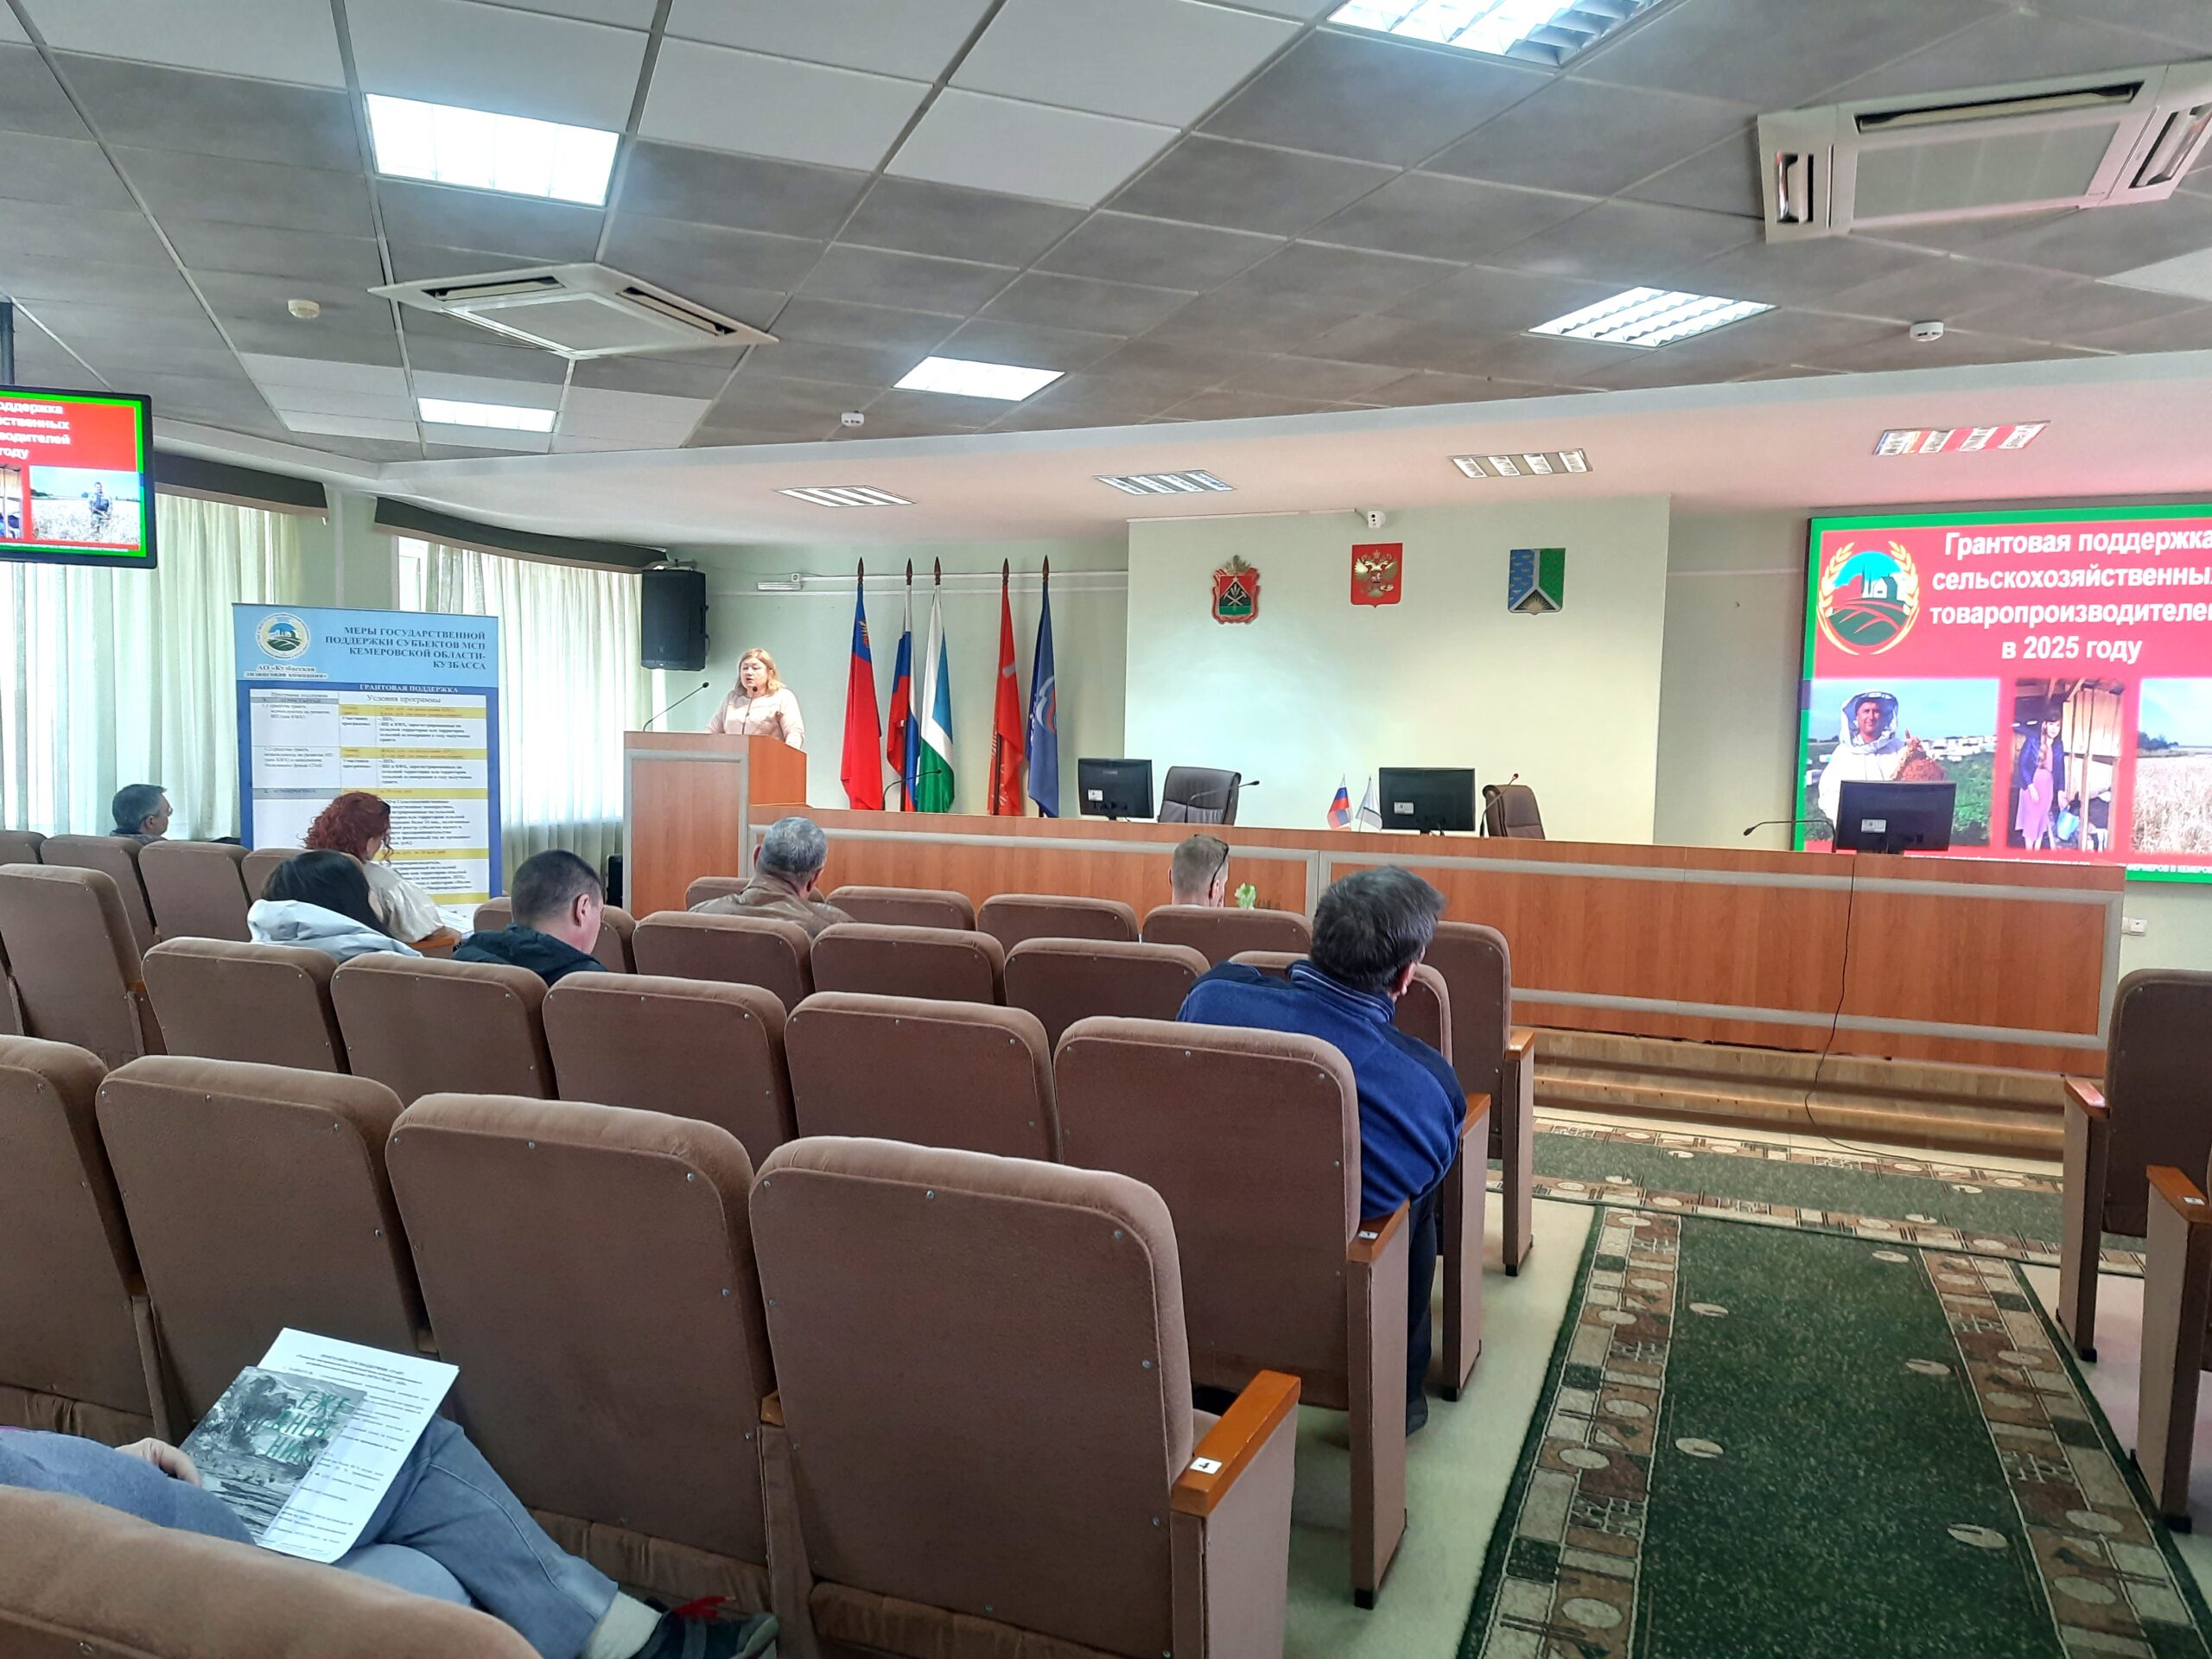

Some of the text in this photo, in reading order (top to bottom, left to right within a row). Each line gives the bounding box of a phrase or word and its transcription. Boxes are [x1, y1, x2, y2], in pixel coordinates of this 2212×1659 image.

[1945, 530, 2212, 561] Грантовая поддержка
[1932, 563, 2212, 590] сельскохозяйственны
[345, 626, 486, 640] МЕРЫ ГОСУДАРСТВЕННОЙ
[326, 636, 486, 650] ПОДДЕРЖКИ СУБЪЕКТОВ МСП
[2001, 635, 2143, 664] в 2025 году
[349, 647, 486, 660] КЕМЕРОВСКОЙ ОБЛАСТИ-
[433, 661, 486, 670] КУЗБАССА
